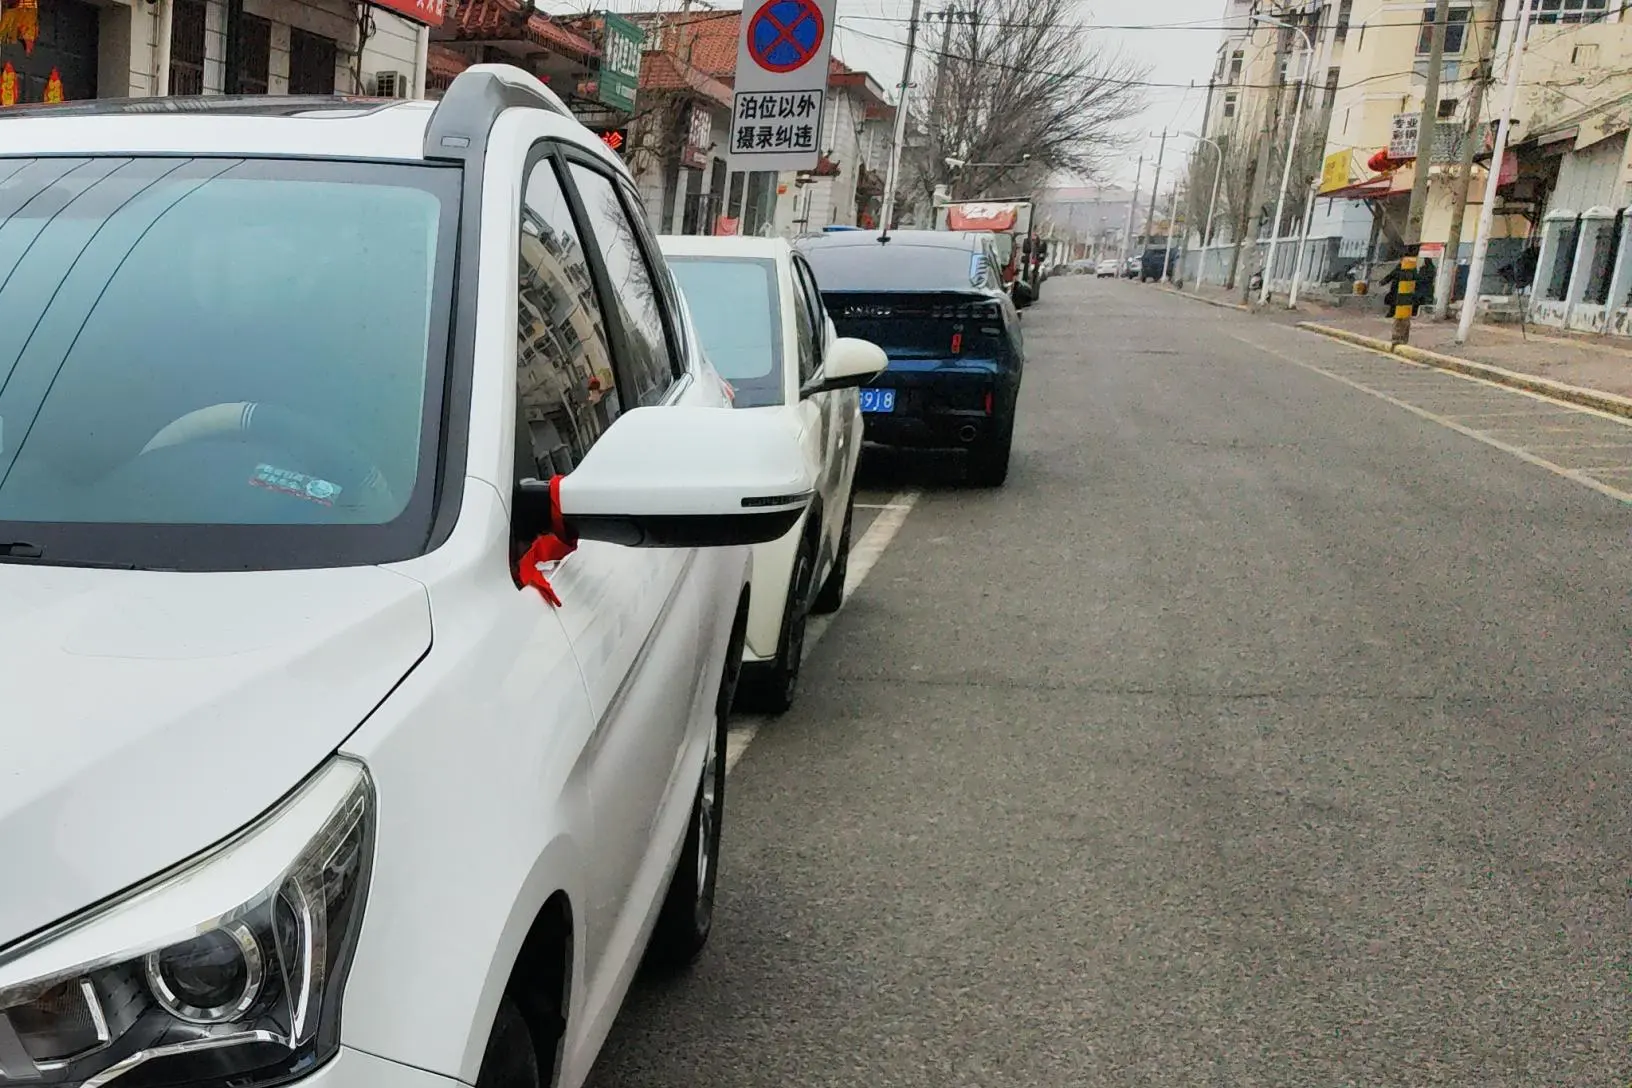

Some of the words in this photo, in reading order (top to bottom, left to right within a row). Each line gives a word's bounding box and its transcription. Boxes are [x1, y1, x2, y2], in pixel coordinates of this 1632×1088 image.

[739, 94, 816, 119] 泊位以外
[736, 124, 813, 149] 摄录纠违
